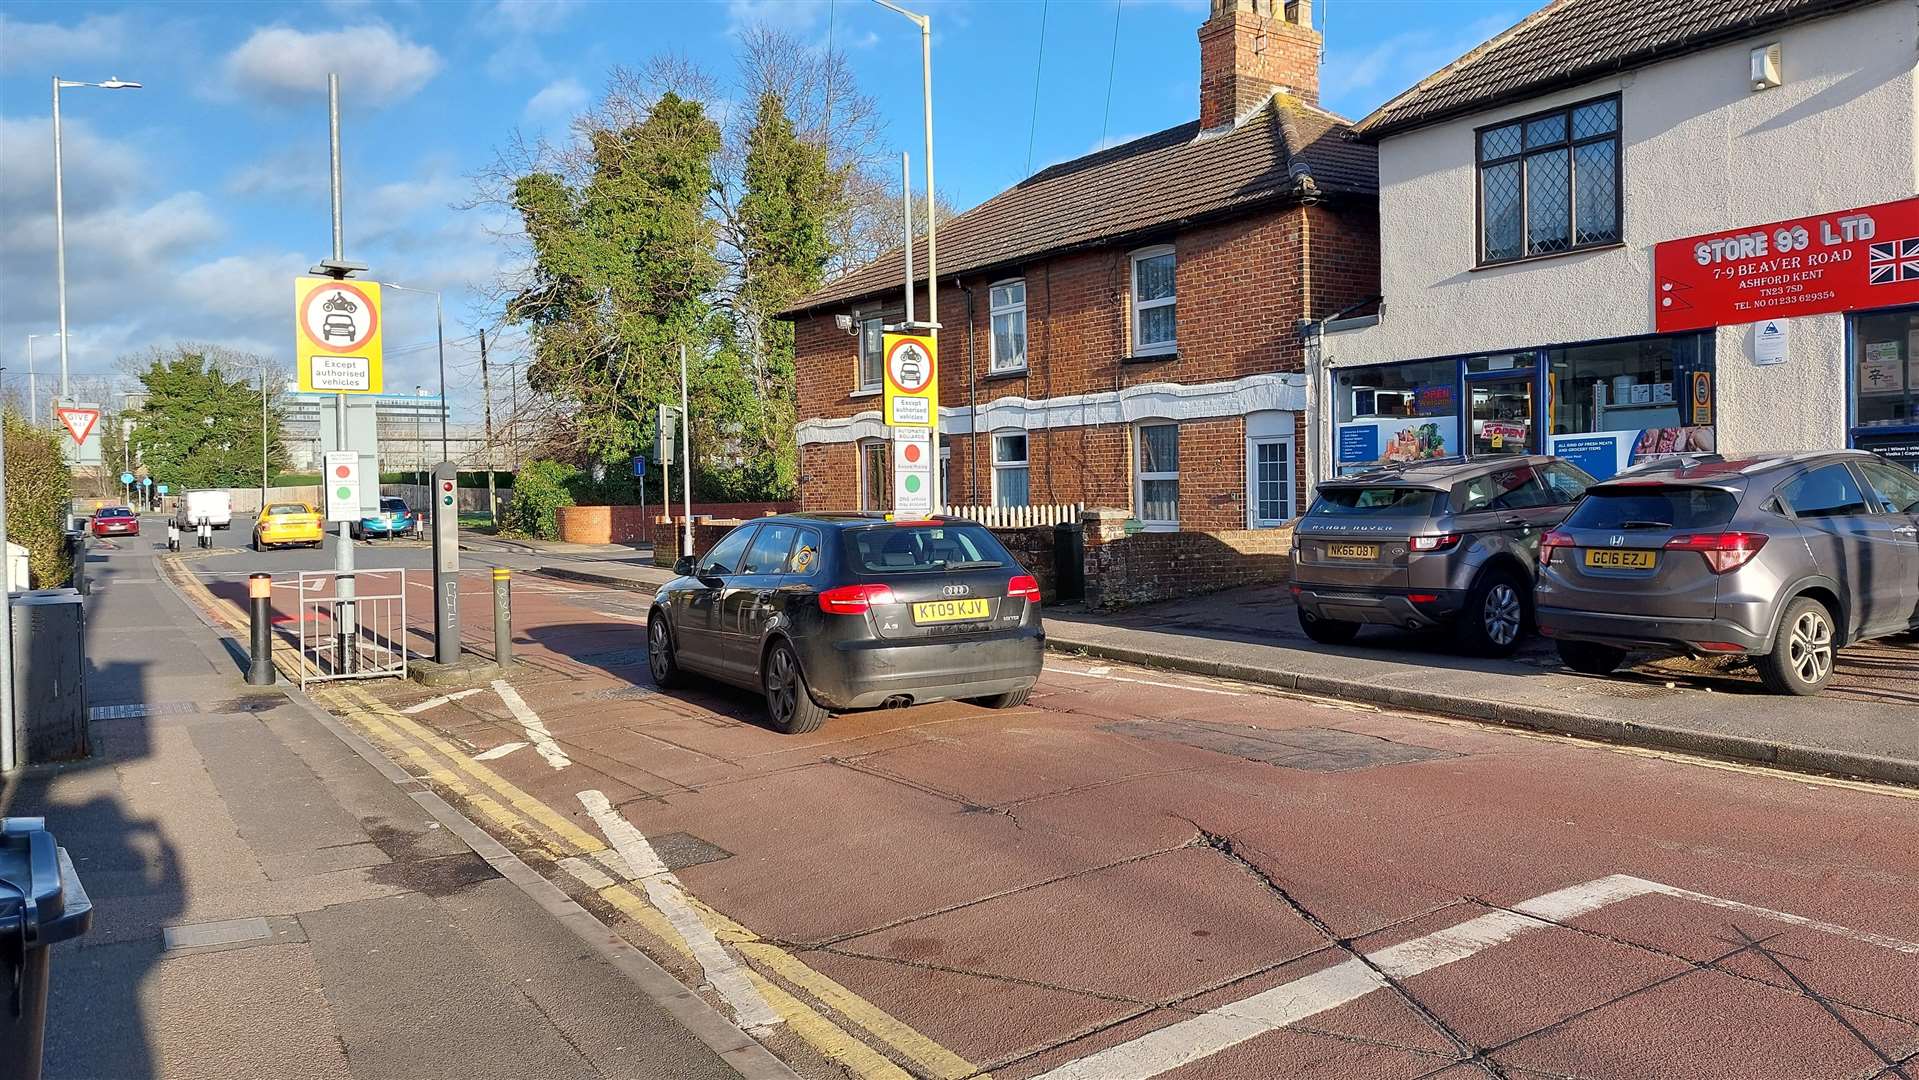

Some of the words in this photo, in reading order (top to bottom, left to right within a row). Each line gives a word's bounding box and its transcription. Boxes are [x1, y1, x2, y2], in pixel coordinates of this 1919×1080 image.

[1694, 231, 1768, 266] STORE
[1773, 224, 1809, 253] 93
[1819, 213, 1876, 246] LTD
[1713, 266, 1735, 280] 7-9
[1738, 256, 1801, 276] BEAVER
[1808, 249, 1852, 267] ROAD
[1738, 273, 1790, 289] ASHFORD
[1792, 269, 1824, 282] KENT
[1760, 287, 1784, 297] TN23
[1786, 284, 1804, 294] 7SD
[1734, 301, 1752, 310] TEL
[1754, 299, 1767, 308] NO
[1768, 295, 1798, 306] 01233
[1799, 290, 1836, 303] 629354
[324, 360, 357, 369] Except
[315, 369, 366, 378] authorised
[900, 399, 922, 407] Except
[67, 413, 89, 421] GIVE
[1493, 427, 1525, 439] OPEN
[1331, 545, 1354, 556] NK66
[1593, 552, 1619, 564] GC16
[1622, 553, 1648, 566] EZJ
[919, 603, 955, 618] KT09
[958, 601, 982, 615] KJV
[883, 622, 899, 630] A3
